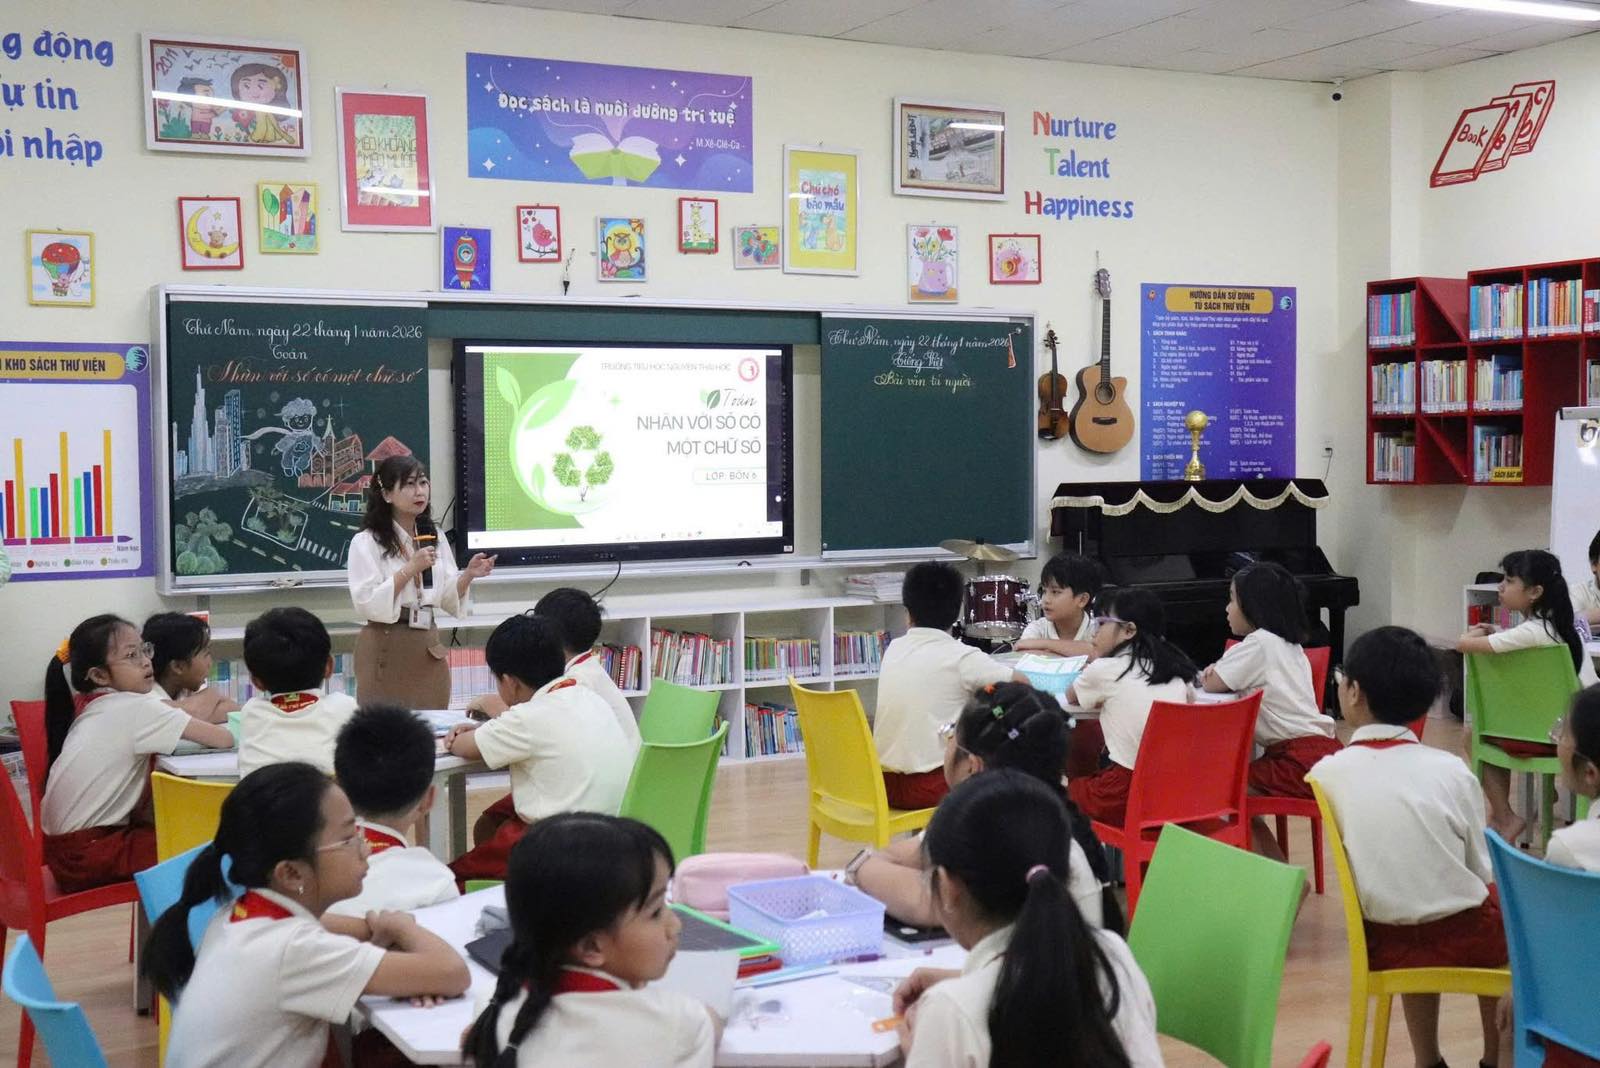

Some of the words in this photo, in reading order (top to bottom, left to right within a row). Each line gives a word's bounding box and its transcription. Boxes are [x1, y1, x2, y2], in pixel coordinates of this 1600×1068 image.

[33, 30, 114, 67] động
[33, 78, 79, 110] tin
[498, 92, 528, 112] Đọc
[532, 94, 570, 113] sách
[574, 98, 591, 115] là
[595, 101, 629, 118] nuôi
[633, 103, 678, 123] dưỡng
[684, 107, 706, 124] trí
[712, 109, 736, 128] tuệ
[1033, 111, 1117, 140] Nurture
[22, 127, 103, 167] nhập
[1044, 148, 1110, 178] Talent
[1024, 190, 1134, 220] Happiness
[183, 318, 213, 336] Thứ
[256, 324, 289, 344] ngày
[292, 323, 311, 337] 22
[314, 320, 350, 345] tháng
[361, 326, 390, 338] năm
[391, 326, 423, 338] 2026
[918, 335, 930, 346] 22
[5, 358, 27, 371] KHO
[29, 356, 57, 371] SÁCH
[60, 358, 80, 371] THƯ
[83, 357, 106, 374] VIỆN
[270, 344, 308, 360] Toán
[637, 412, 684, 430] NHÂN
[687, 412, 712, 430] VỚI
[716, 412, 736, 430] SỐ
[740, 412, 761, 430] CÓ
[667, 437, 702, 457] MỘT
[704, 437, 738, 455] CHỮ
[741, 436, 762, 454] SỐ
